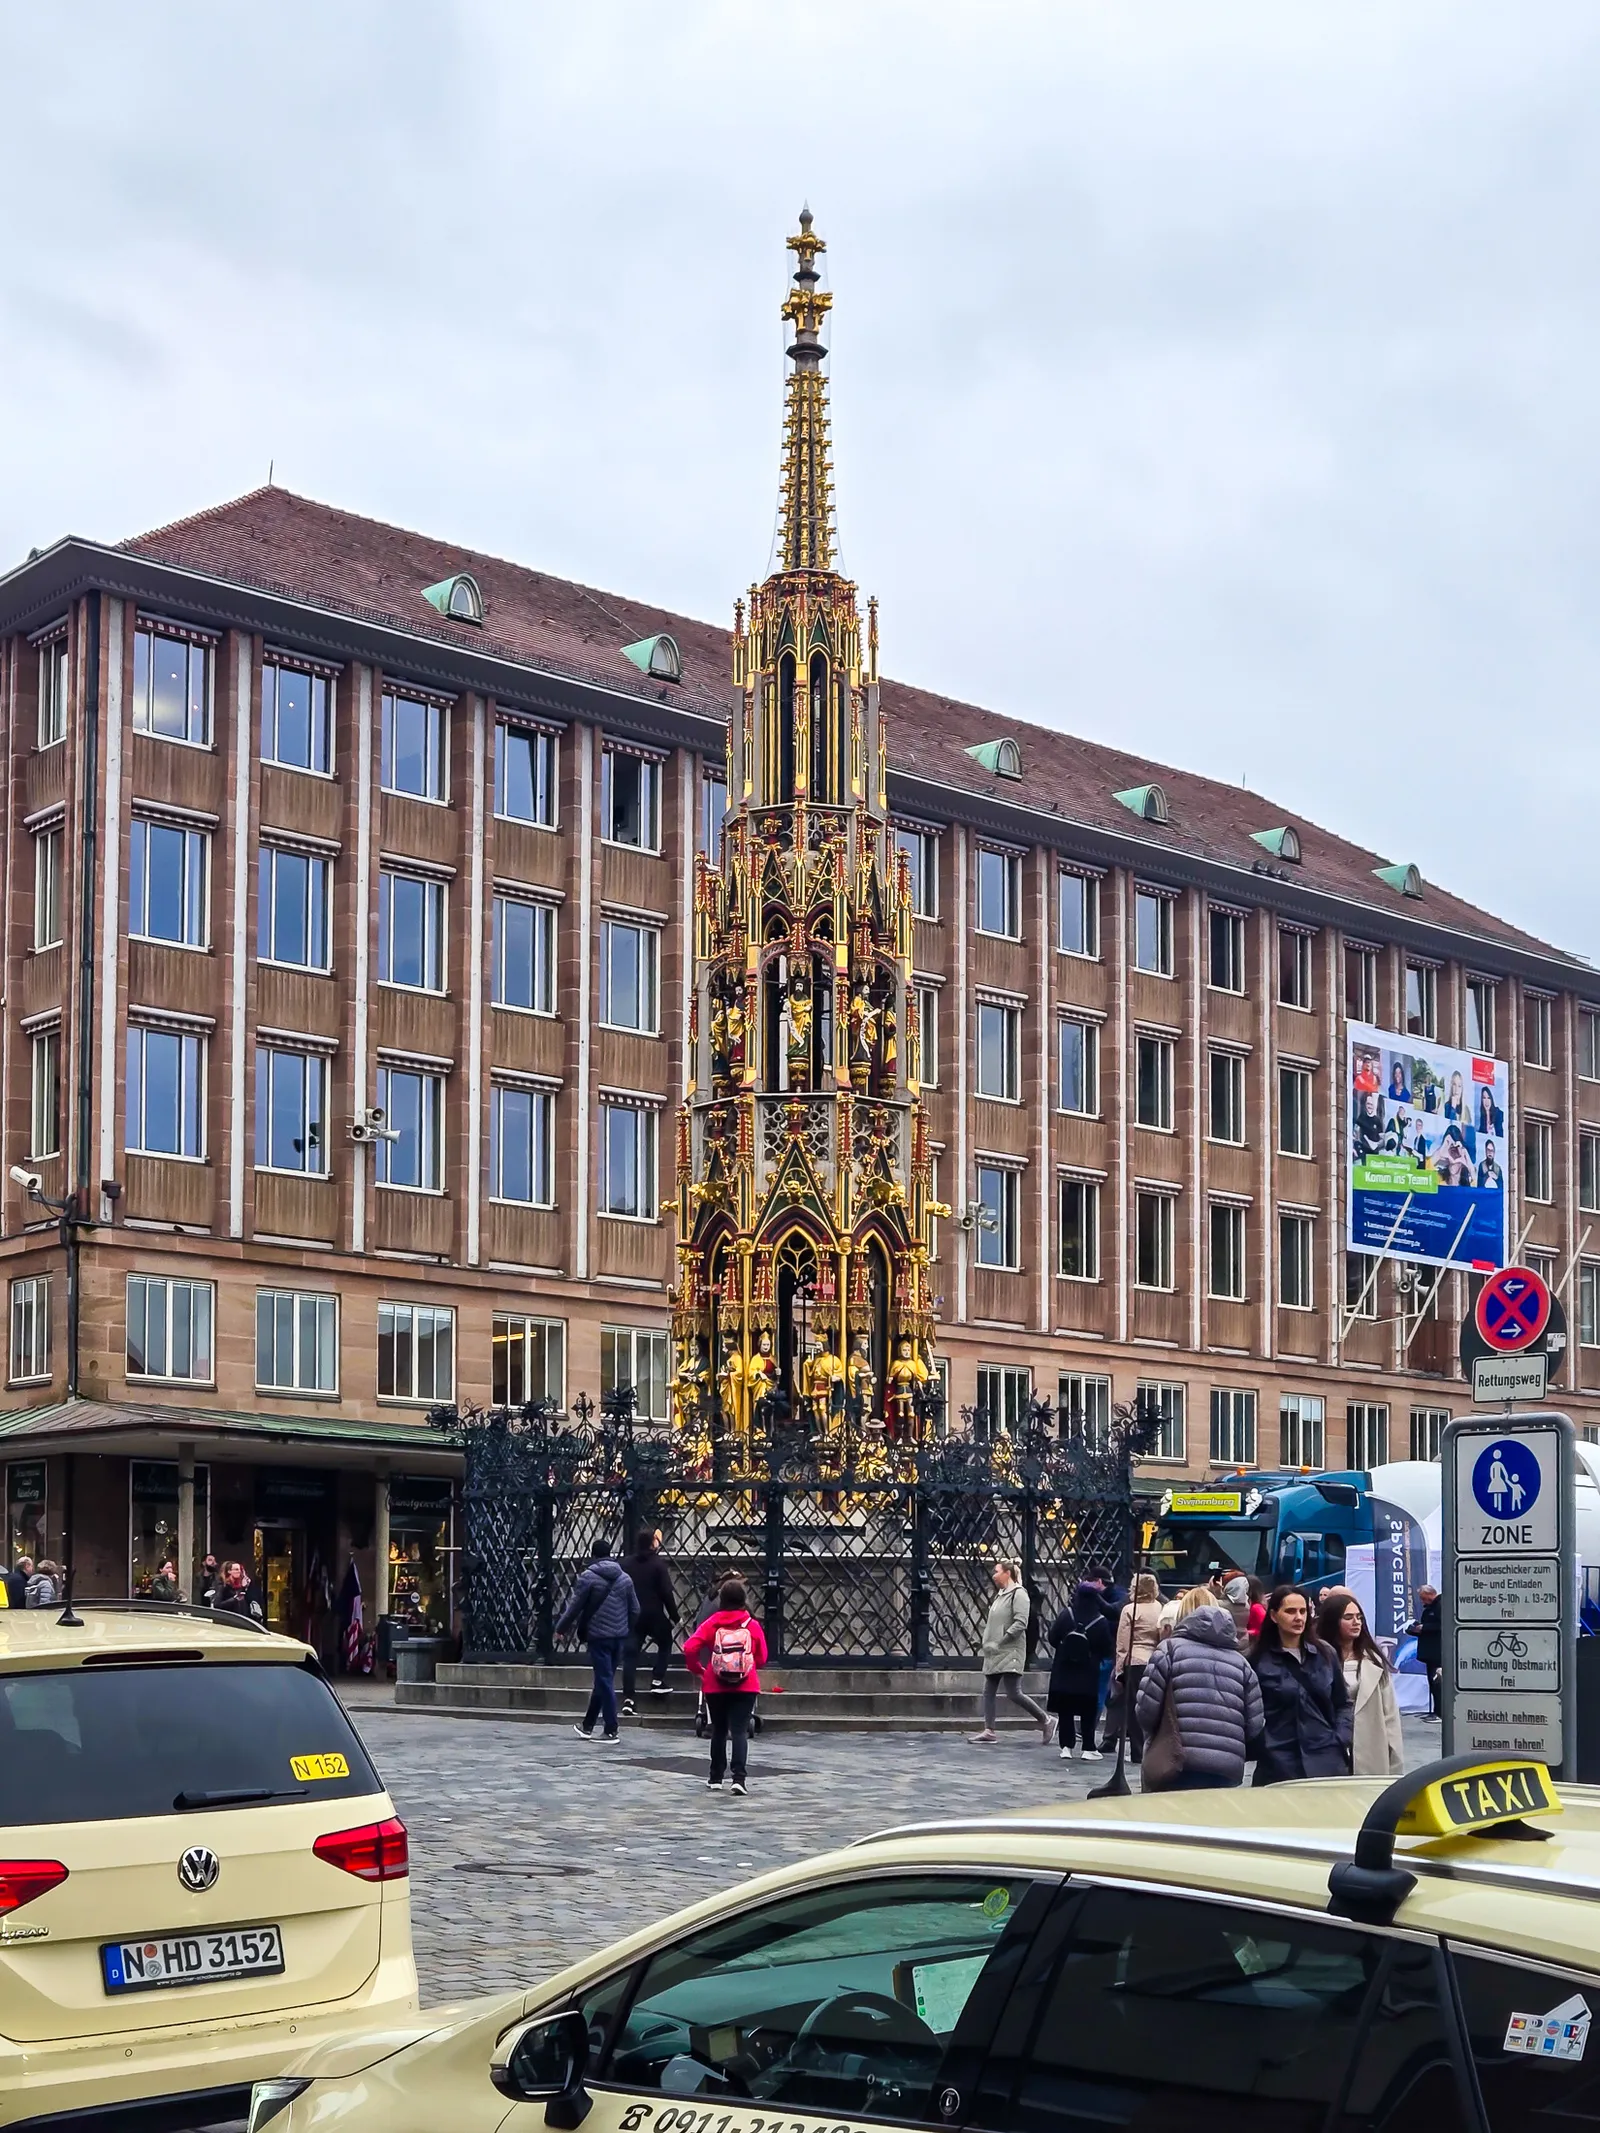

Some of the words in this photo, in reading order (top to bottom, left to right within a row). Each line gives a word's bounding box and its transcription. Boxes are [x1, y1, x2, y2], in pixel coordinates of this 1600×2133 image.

[1364, 1171, 1392, 1183] Komm
[1393, 1172, 1405, 1184] ins
[1478, 1374, 1541, 1389] Rettungsweg
[1481, 1525, 1533, 1545] ZONE
[1464, 1564, 1530, 1575] Marktbeschicker
[1533, 1565, 1551, 1574] zum
[1472, 1579, 1488, 1589] Be-
[1490, 1579, 1505, 1589] und
[1507, 1579, 1542, 1589] Entladen
[1459, 1594, 1497, 1606] werktags
[1498, 1593, 1520, 1604] 5-10h
[1532, 1593, 1556, 1604] 13-21h
[1501, 1608, 1515, 1618] frei
[1460, 1658, 1468, 1670] in
[1471, 1658, 1508, 1673] Richtung
[1511, 1659, 1556, 1671] Obstmarkt
[1500, 1675, 1516, 1687] frei
[1467, 1709, 1508, 1722] Rücksicht
[1472, 1736, 1510, 1749] Langsam
[1514, 1738, 1545, 1749] fahren!
[294, 1759, 311, 1778] N
[314, 1756, 346, 1775] 152
[1453, 1772, 1535, 1818] TAXI
[123, 1946, 145, 1979] N
[162, 1940, 202, 1974] HD
[207, 1932, 278, 1968] 3152
[112, 1969, 119, 1979] D
